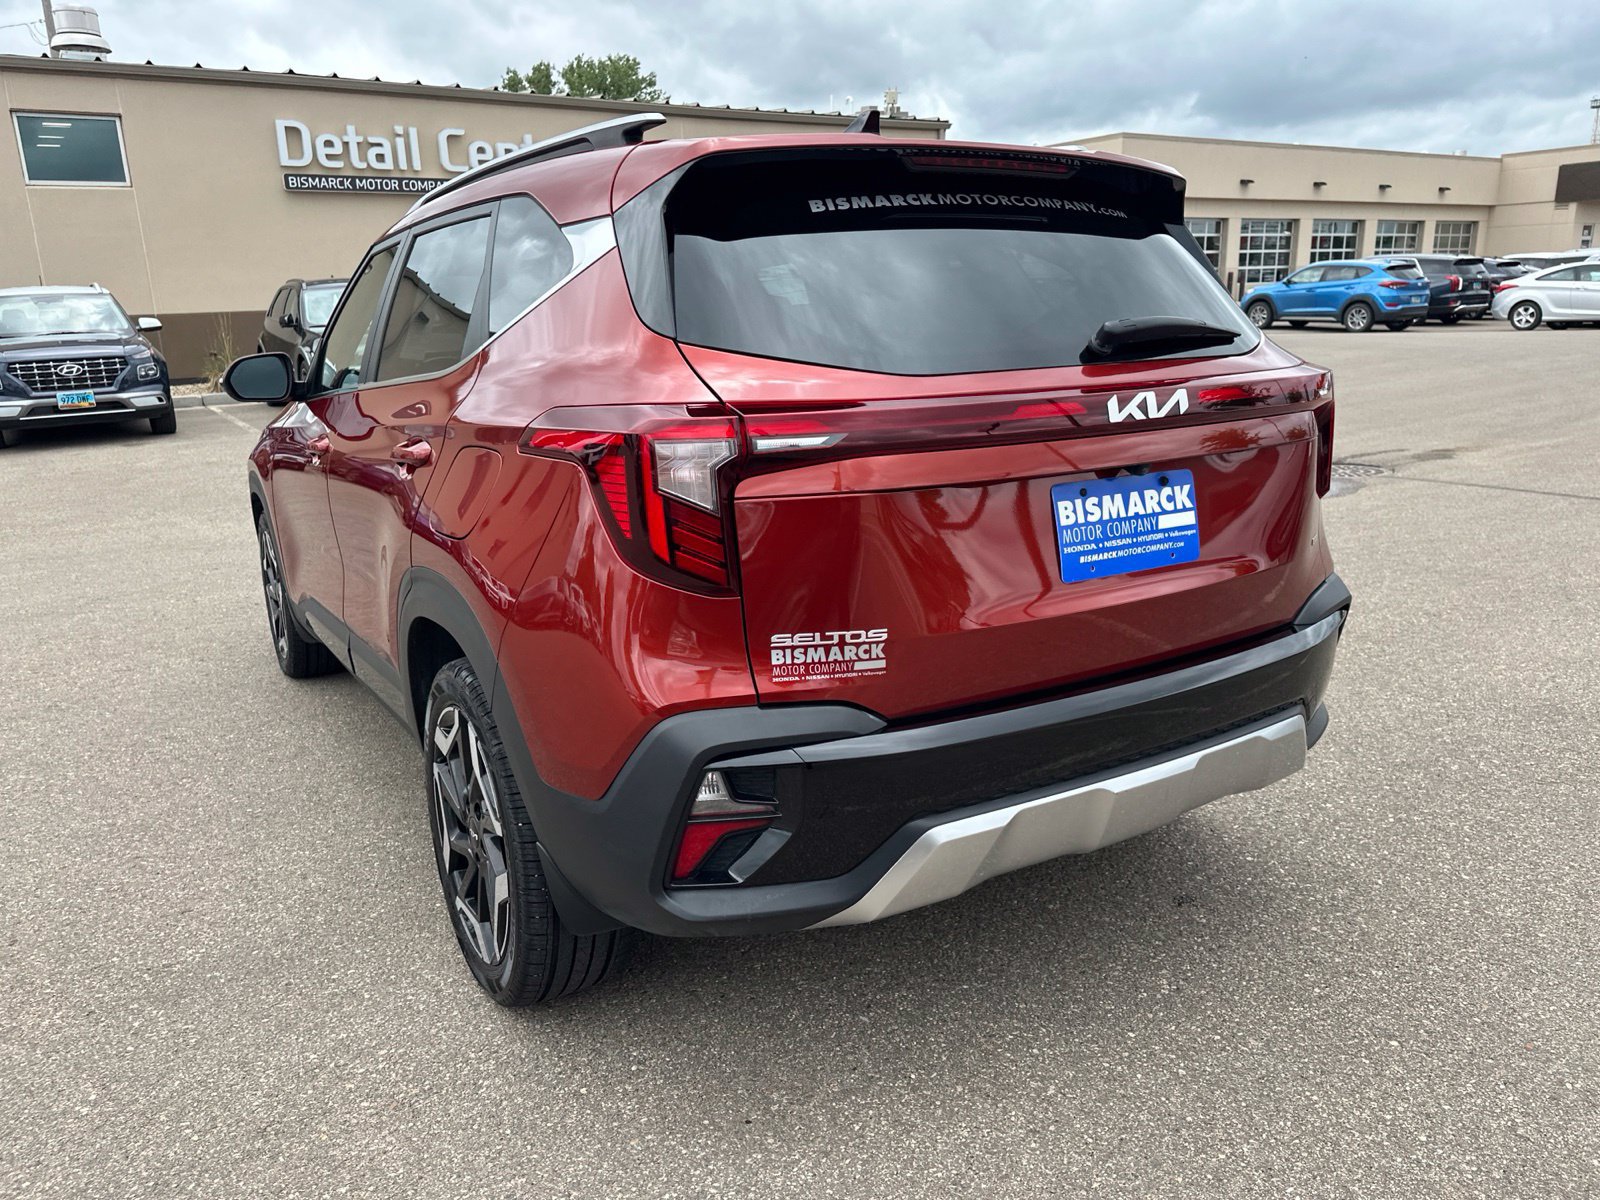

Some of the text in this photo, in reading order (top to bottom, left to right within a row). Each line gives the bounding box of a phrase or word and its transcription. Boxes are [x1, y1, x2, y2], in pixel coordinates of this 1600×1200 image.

[275, 119, 533, 172] Detail Cen
[288, 176, 447, 191] BISMARCK MOTOR COMPA
[61, 396, 75, 404] 972
[1107, 388, 1189, 423] KIA
[1057, 484, 1194, 527] BISMARCK
[1063, 516, 1157, 544] MOTOR COMPANY
[1063, 543, 1097, 554] HONDA
[1104, 537, 1132, 548] NISSAN
[1137, 532, 1165, 543] HYUNDAI
[770, 628, 888, 647] SELTOS
[770, 643, 886, 665] BISMARCK
[772, 662, 853, 677] MOTOR COMPANY
